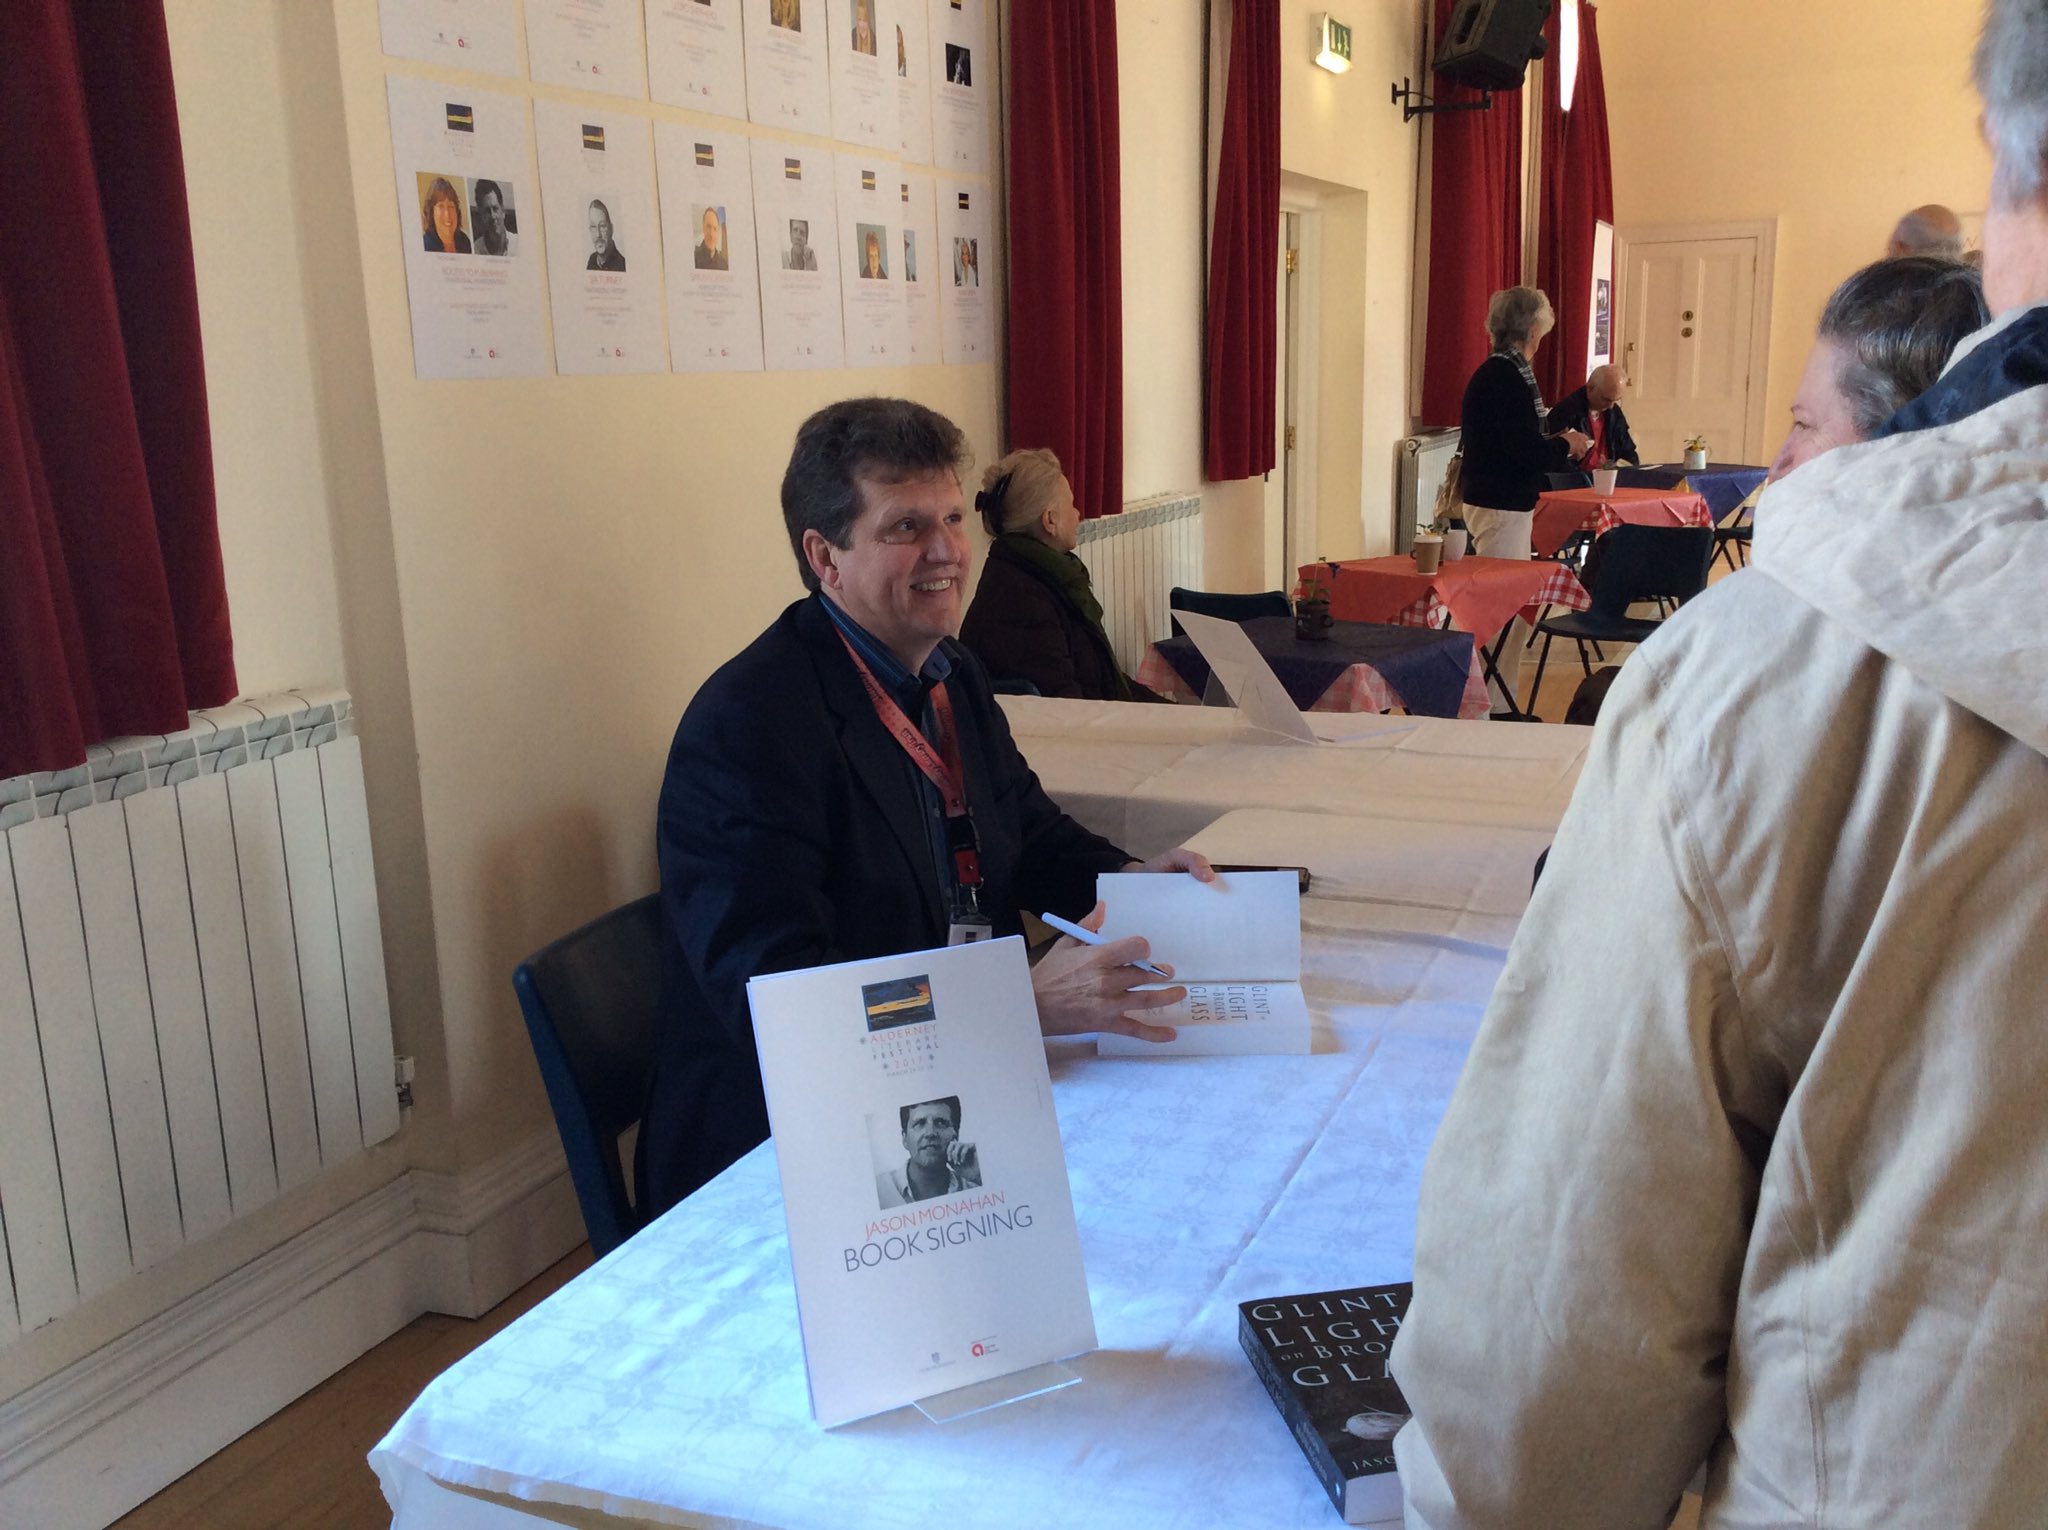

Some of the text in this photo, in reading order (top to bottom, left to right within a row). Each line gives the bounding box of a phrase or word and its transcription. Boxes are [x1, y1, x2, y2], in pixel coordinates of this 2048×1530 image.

[1189, 986, 1210, 1021] GLASS
[1227, 986, 1248, 1021] LIGHT
[1251, 985, 1271, 1015] GLINT
[865, 1191, 1006, 1241] JASON MONAHAN
[844, 1205, 1033, 1273] BOOK SIGNING
[1251, 1292, 1399, 1322] GLINT
[1265, 1315, 1402, 1348] LIGH
[1313, 1340, 1392, 1359] BRO
[1351, 1455, 1397, 1471] JASO
